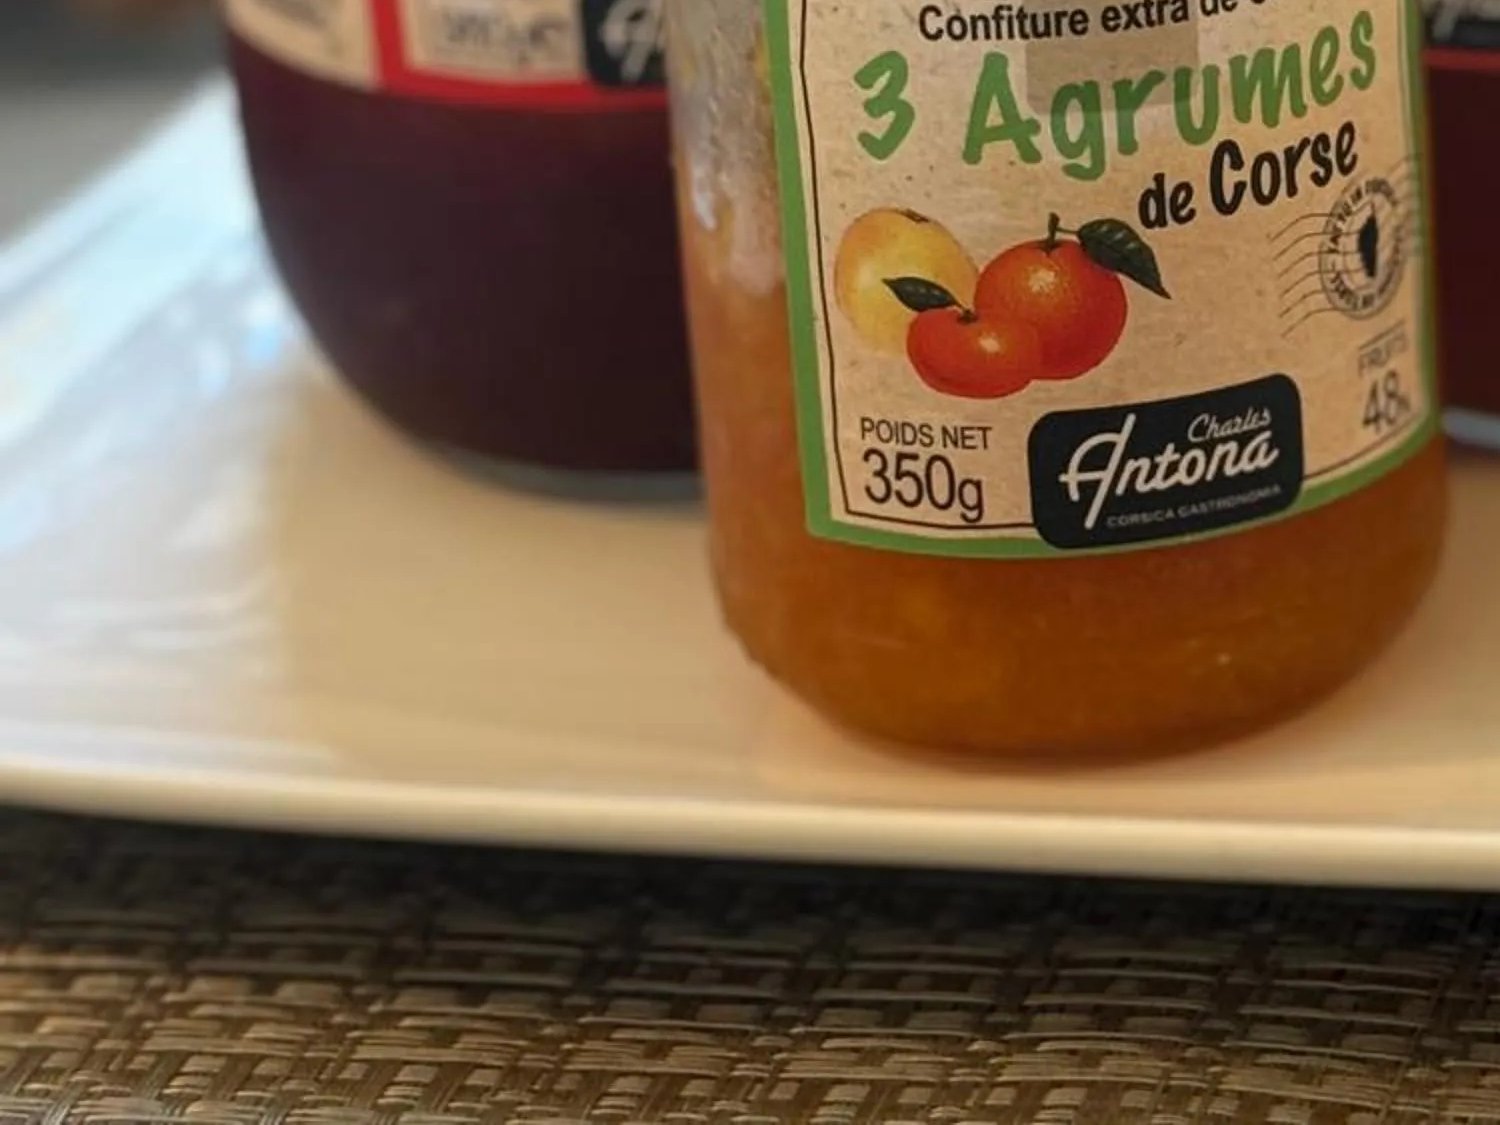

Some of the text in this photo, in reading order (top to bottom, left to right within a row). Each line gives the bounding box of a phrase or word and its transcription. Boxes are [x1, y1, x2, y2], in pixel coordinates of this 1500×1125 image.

[919, 3, 1089, 43] Confiture
[853, 10, 1377, 182] 3 Agrumes
[1138, 173, 1197, 230] de
[1209, 121, 1357, 216] Corse
[860, 416, 993, 451] POIDS NET
[1188, 406, 1272, 443] Charles
[863, 447, 984, 524] 350g
[1058, 412, 1280, 530] Antona
[1106, 501, 1176, 528] CORSICA
